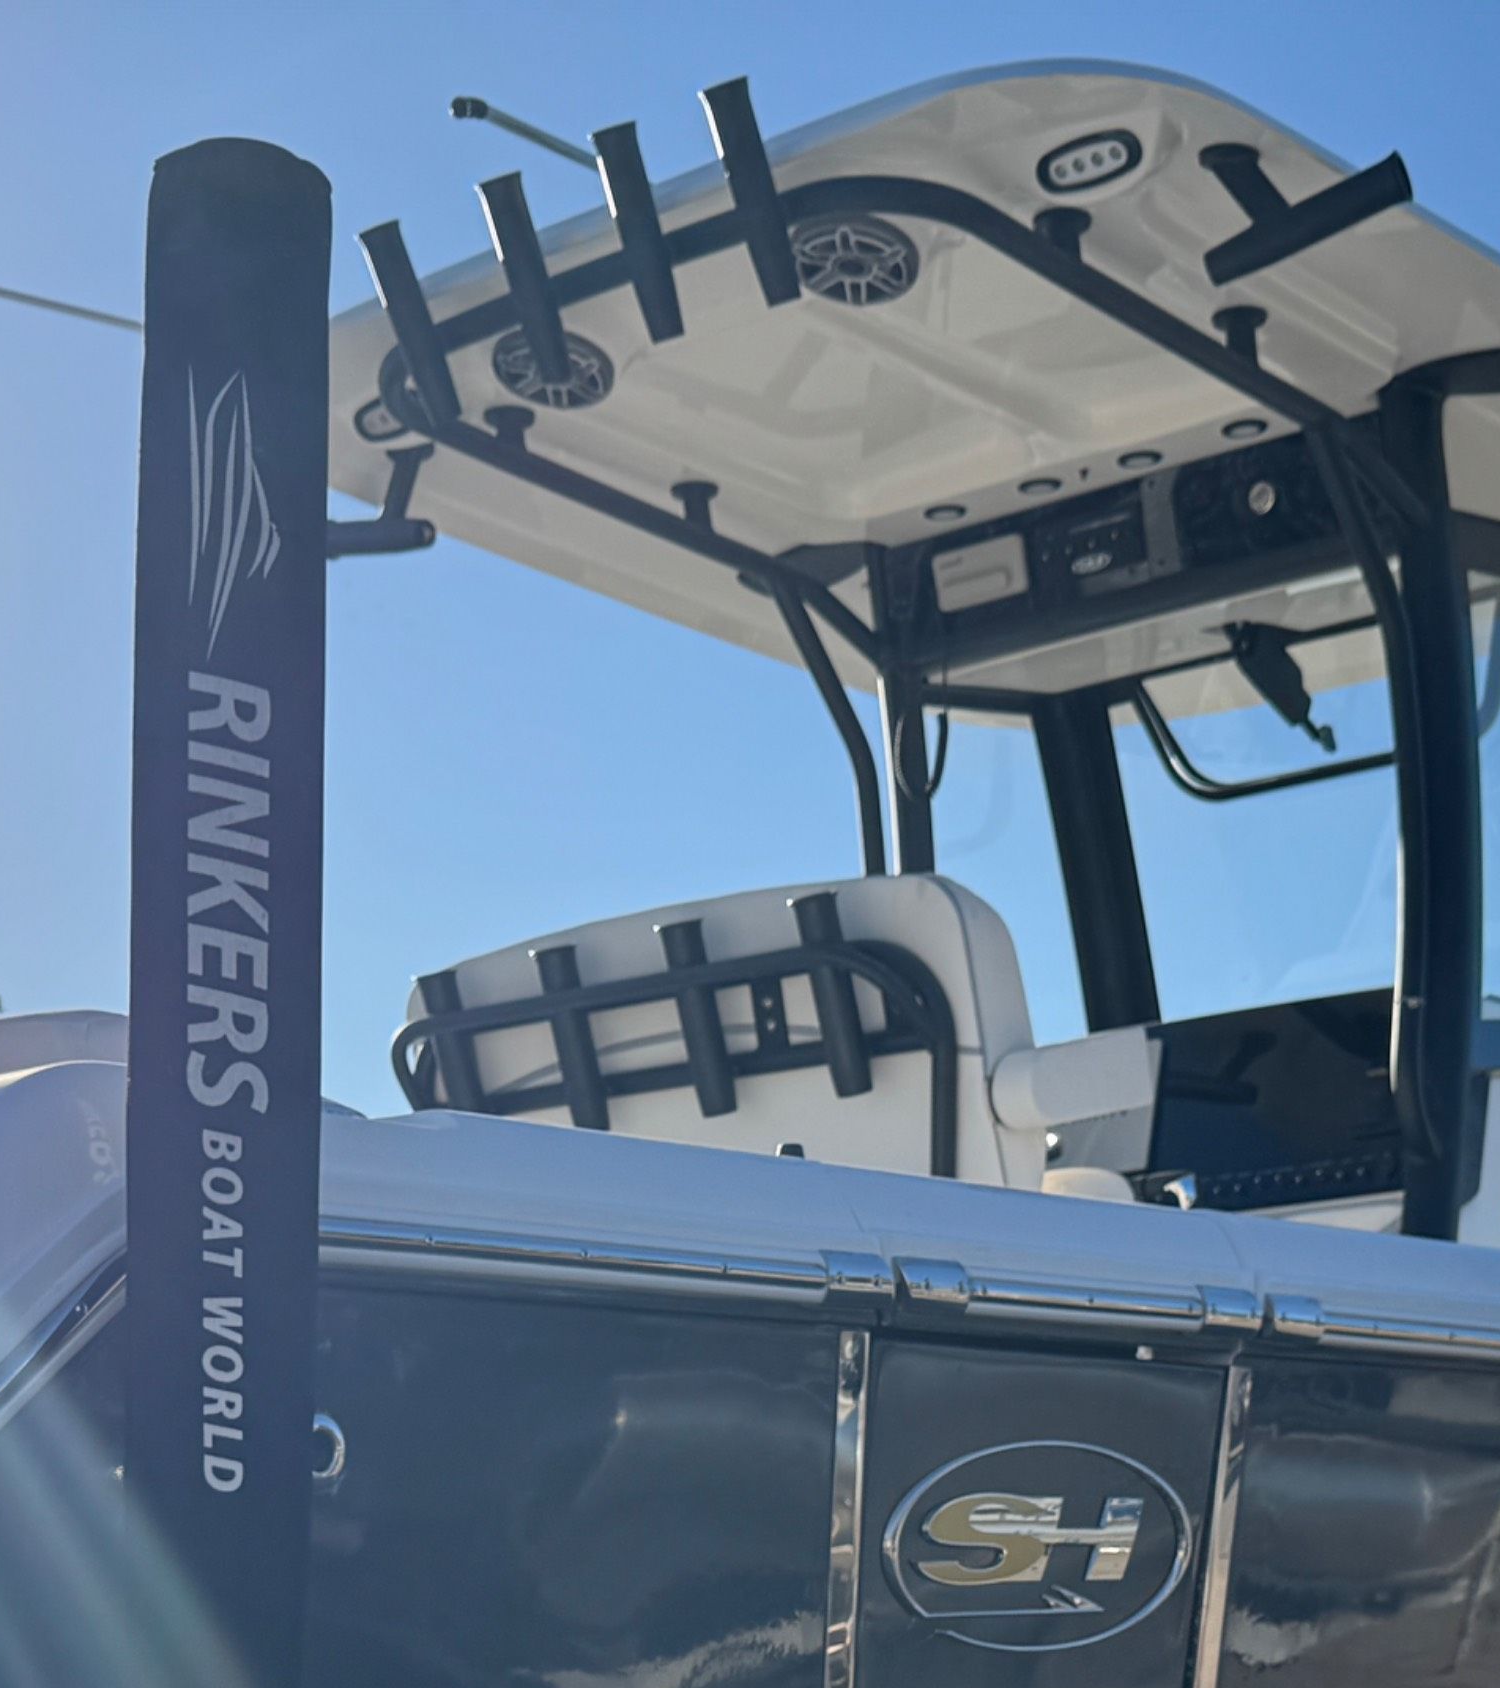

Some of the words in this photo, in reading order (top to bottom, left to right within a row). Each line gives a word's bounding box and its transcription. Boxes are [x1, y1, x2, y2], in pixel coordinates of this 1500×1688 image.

[186, 671, 271, 1114] RINKERS
[201, 1128, 244, 1278] BOAT
[202, 1297, 244, 1492] WORLD
